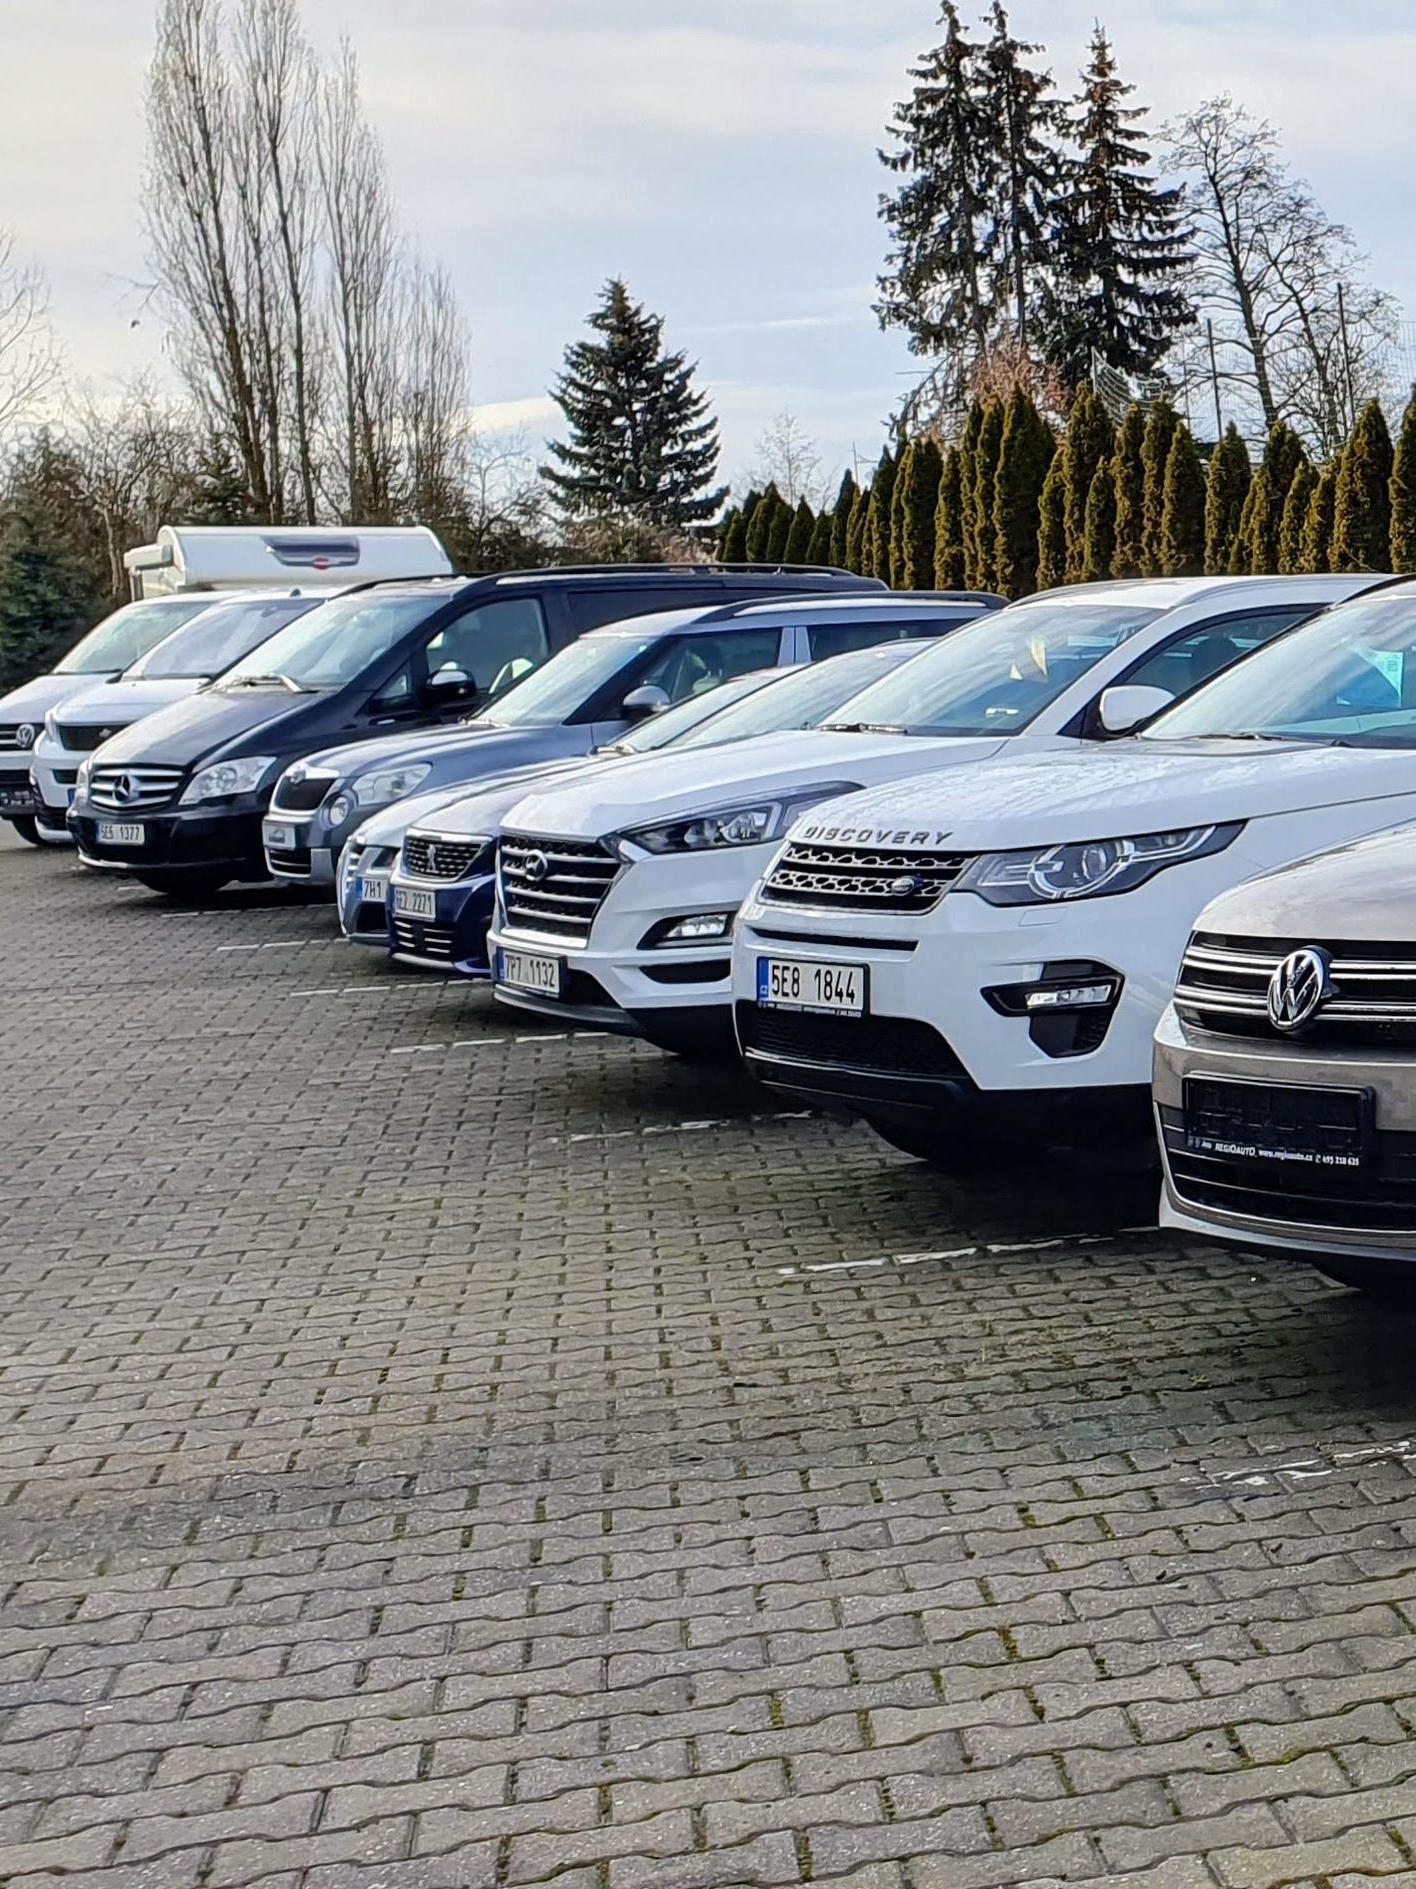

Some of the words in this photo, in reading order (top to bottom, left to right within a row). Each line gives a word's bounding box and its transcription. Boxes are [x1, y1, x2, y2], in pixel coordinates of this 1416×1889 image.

[803, 826, 954, 846] DISCOVERY
[364, 880, 382, 899] 7H1
[771, 964, 801, 998] 5E8
[814, 968, 856, 1005] 1844
